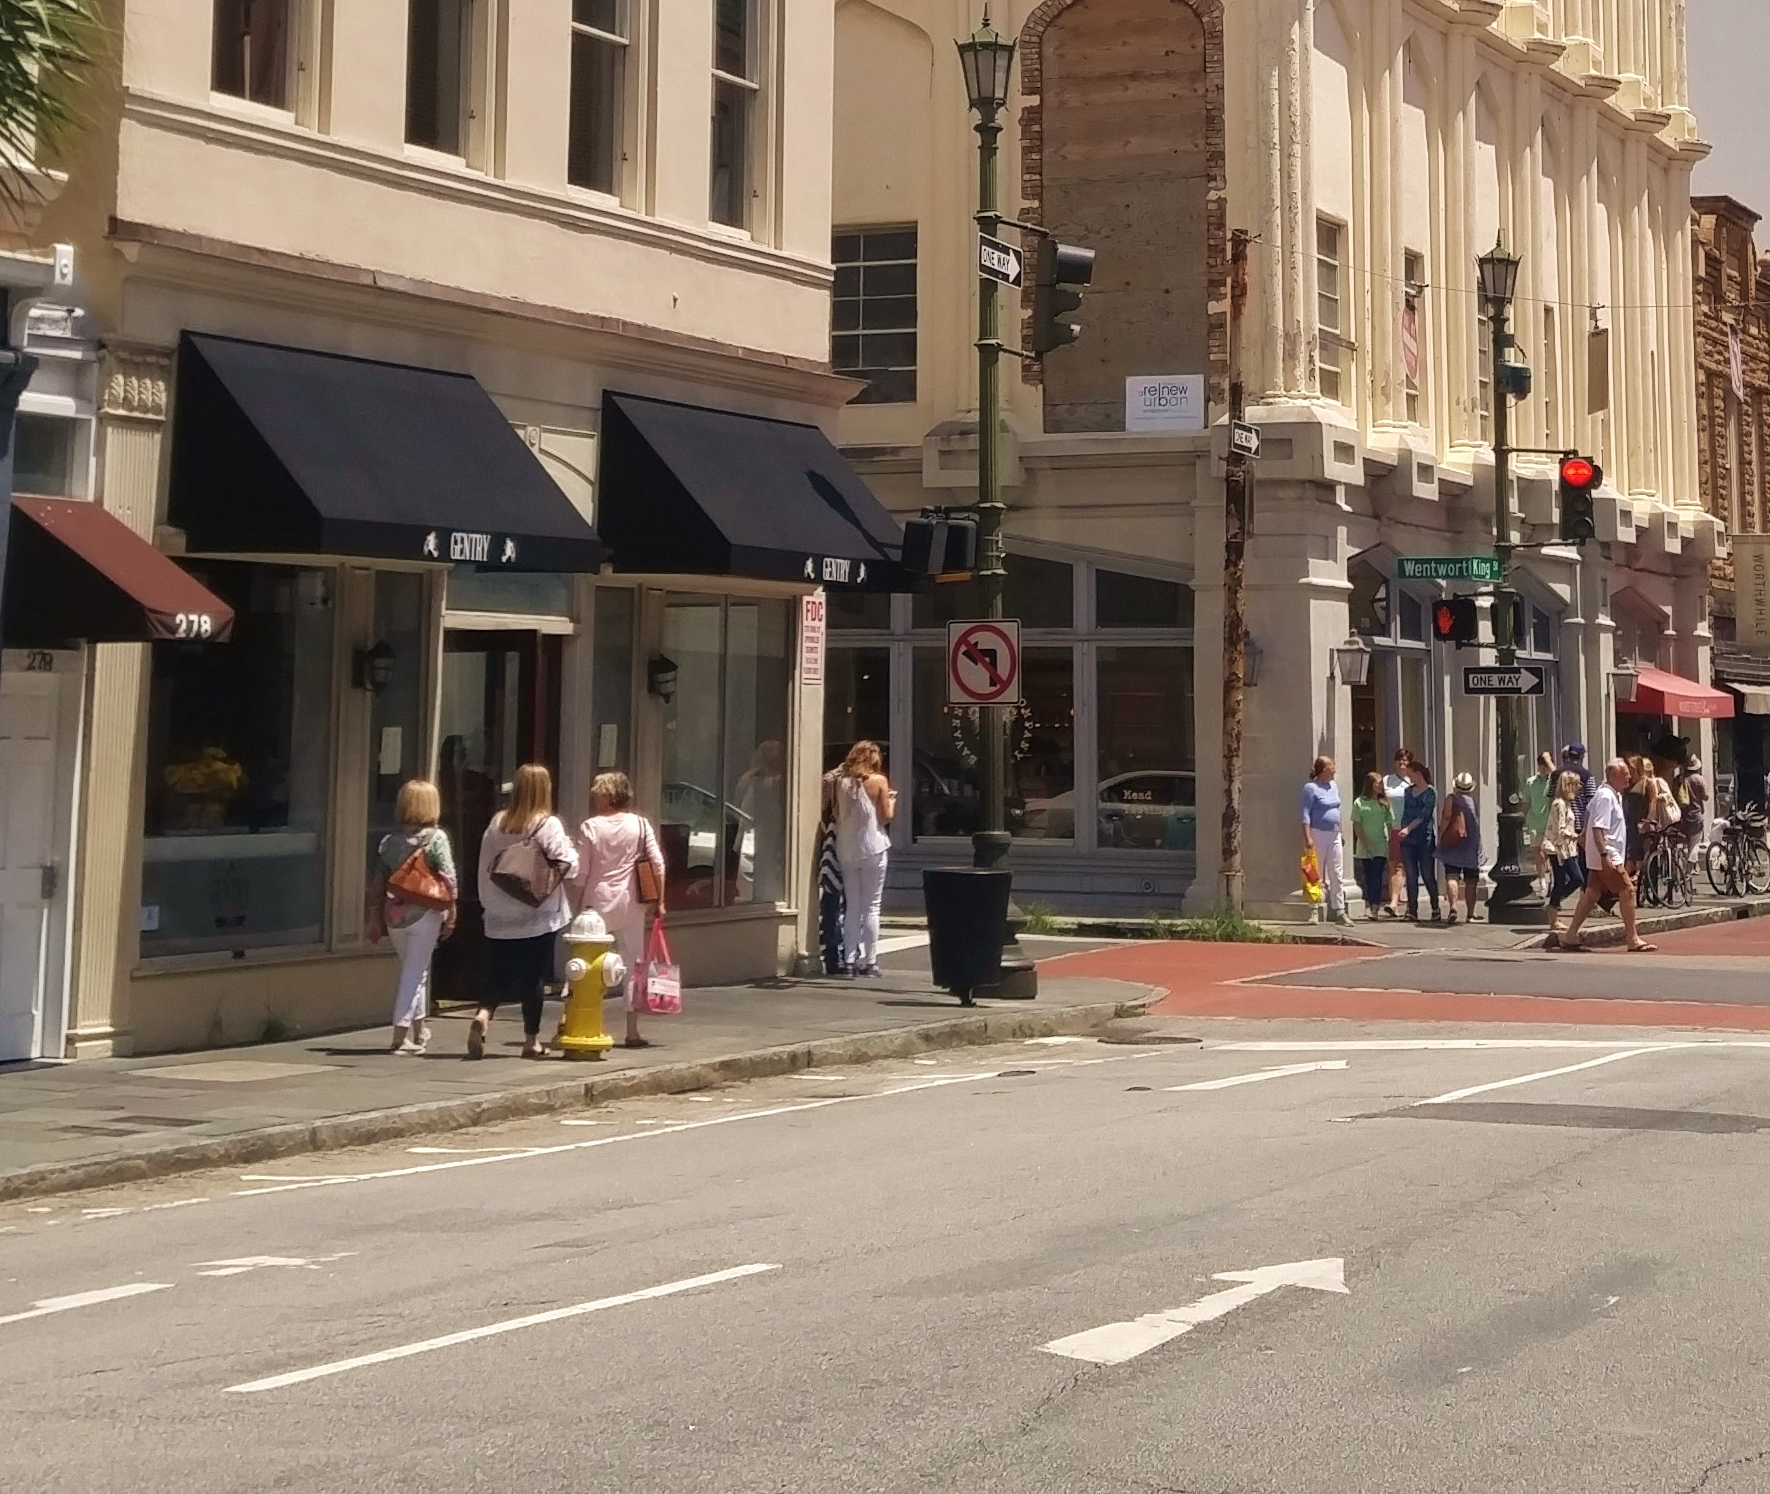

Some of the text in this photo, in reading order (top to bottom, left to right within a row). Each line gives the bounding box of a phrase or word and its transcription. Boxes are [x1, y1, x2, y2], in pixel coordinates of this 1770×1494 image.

[983, 248, 1010, 272] ONE WAY
[450, 532, 491, 562] GENTRY
[823, 557, 851, 583] GENTRY
[1472, 558, 1491, 579] King
[1753, 553, 1767, 637] WORTHWHILE
[806, 600, 824, 622] FDC
[175, 613, 211, 639] 278
[28, 651, 54, 672] 278
[1472, 675, 1521, 686] ONE WAY
[1123, 789, 1152, 801] Mead
